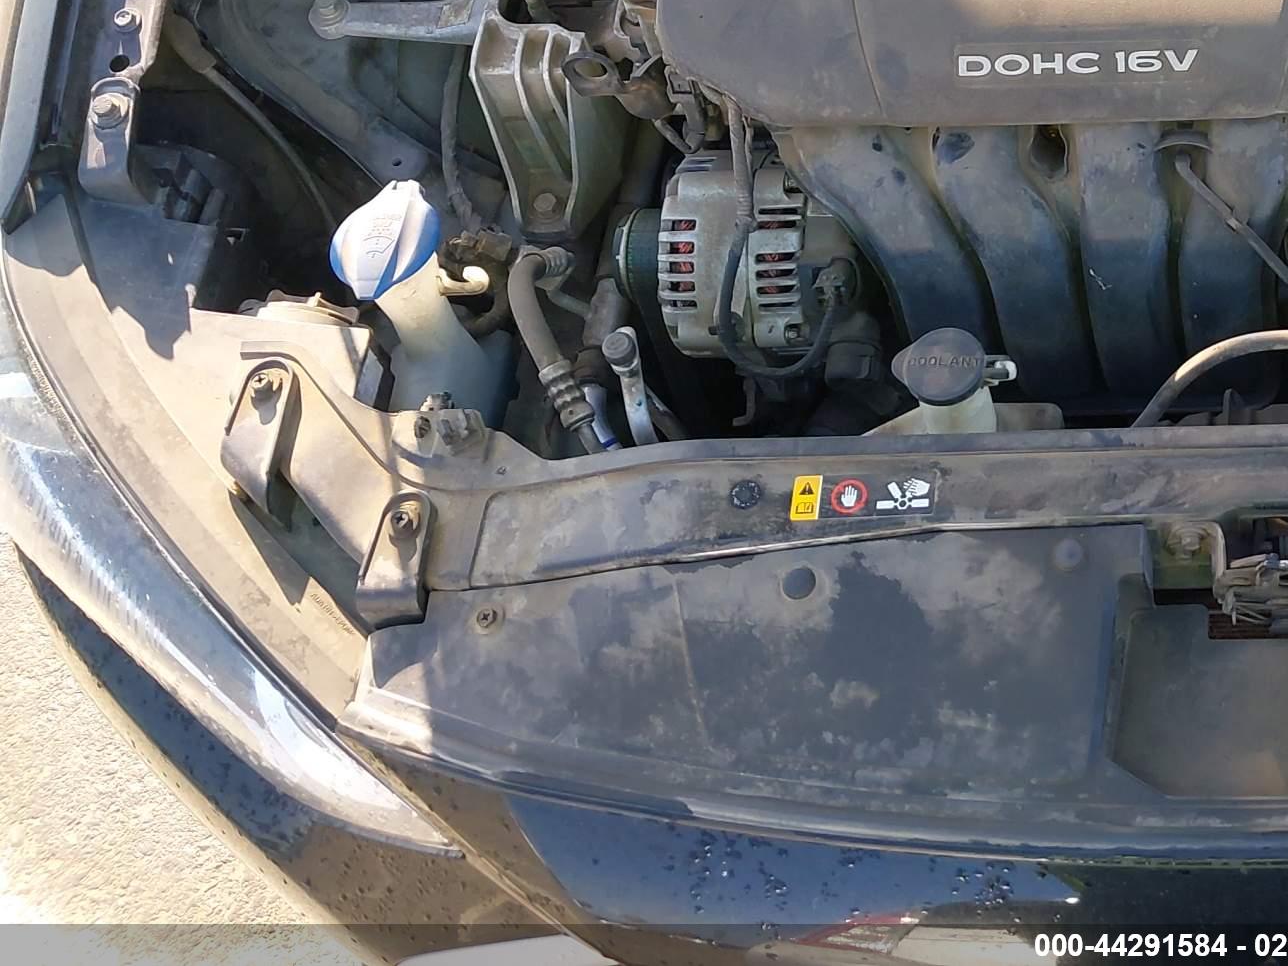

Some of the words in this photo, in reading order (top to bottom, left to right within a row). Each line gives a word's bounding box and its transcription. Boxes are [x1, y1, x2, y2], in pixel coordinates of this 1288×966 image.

[958, 52, 1100, 77] DOHC
[1114, 49, 1199, 73] 16V
[907, 355, 980, 369] COOLANT
